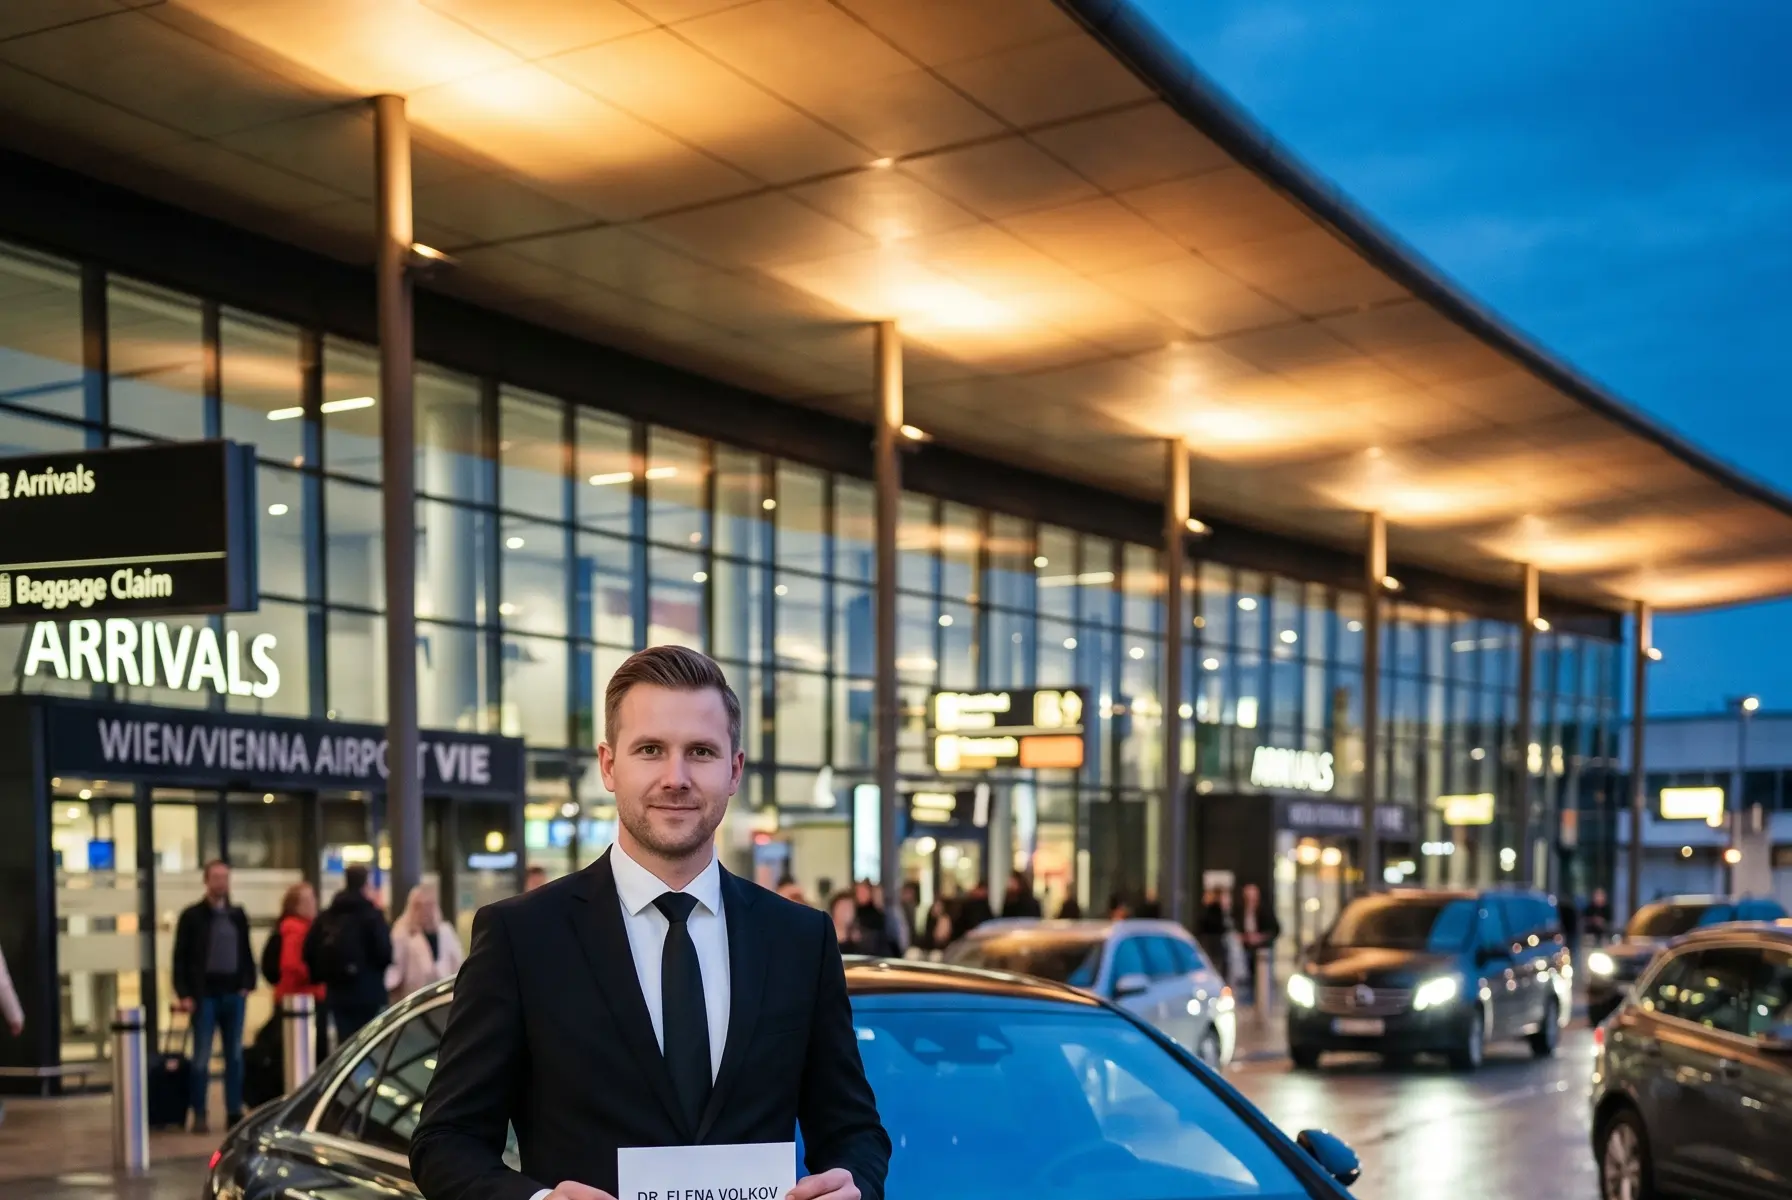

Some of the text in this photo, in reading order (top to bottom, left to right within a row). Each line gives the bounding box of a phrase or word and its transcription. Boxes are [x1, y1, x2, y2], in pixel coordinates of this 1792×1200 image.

[14, 463, 96, 498] Arrivals
[16, 567, 173, 610] Baggage Claim
[24, 618, 280, 698] ARRIVALS
[98, 717, 491, 784] WIEN/VIENNA AIRPOT VIE
